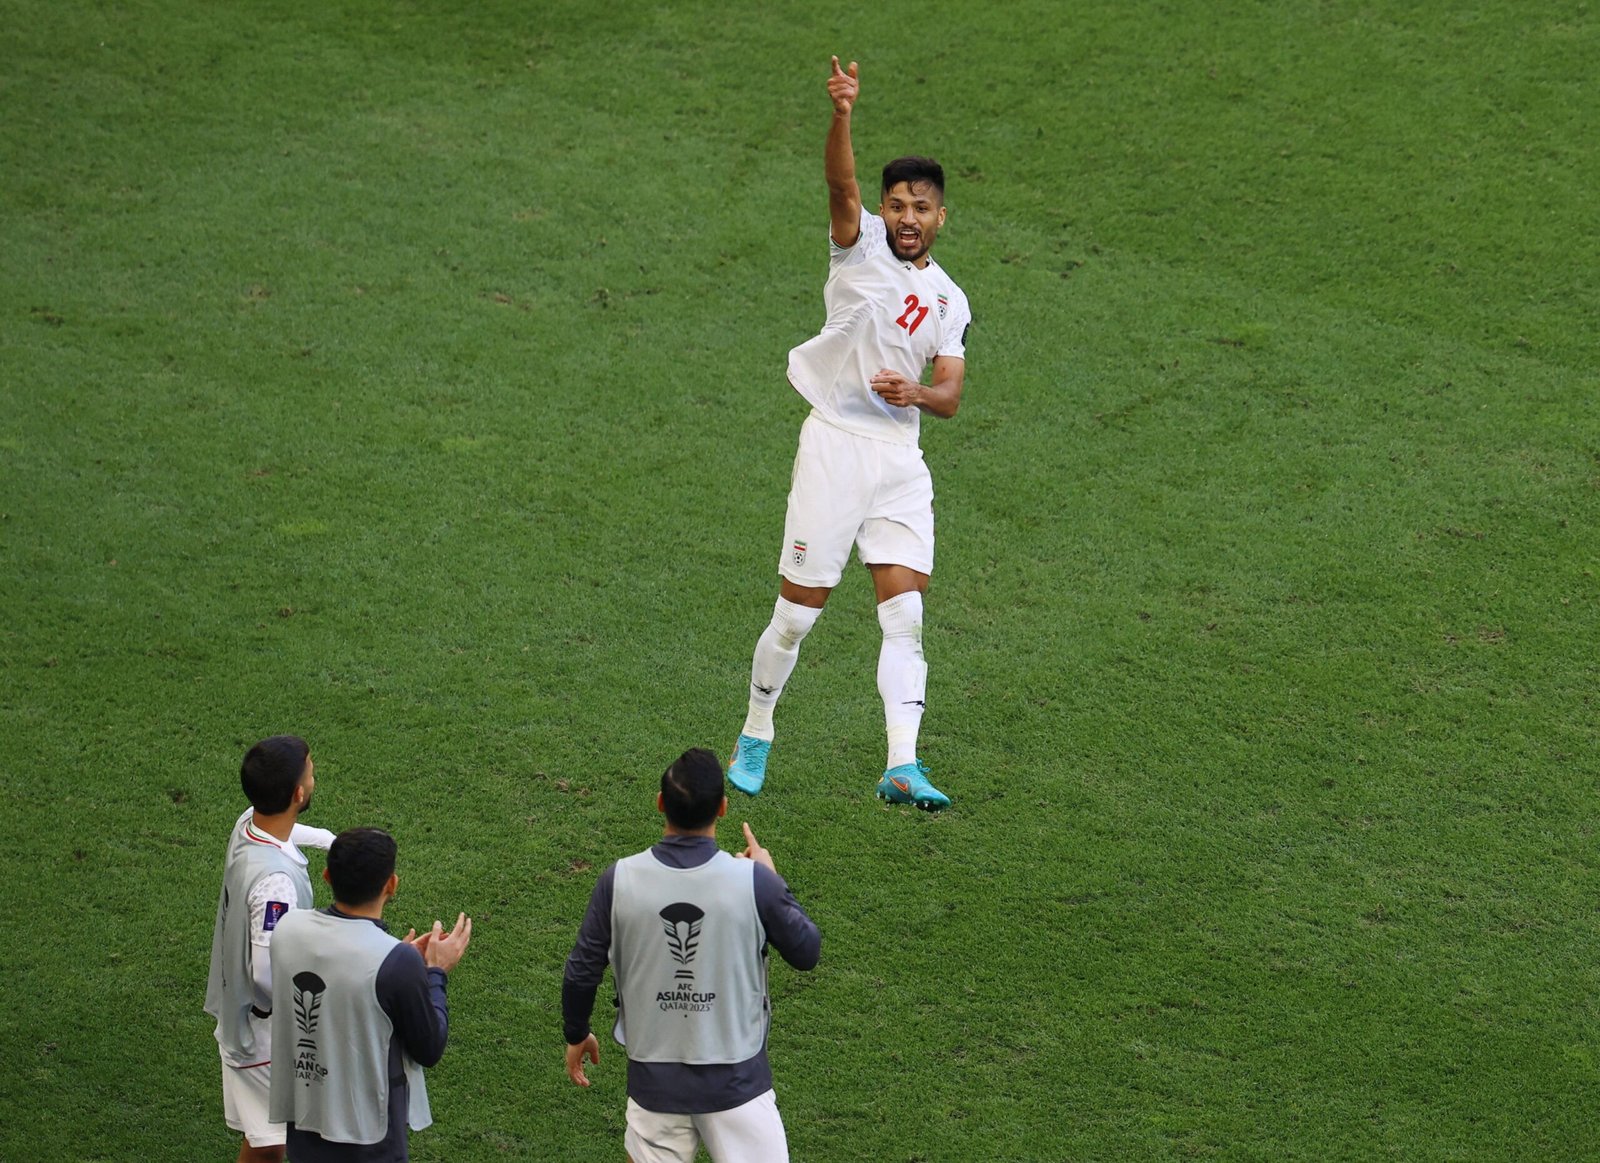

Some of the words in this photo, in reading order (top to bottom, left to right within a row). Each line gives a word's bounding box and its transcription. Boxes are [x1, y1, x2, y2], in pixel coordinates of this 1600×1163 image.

[896, 294, 930, 337] 21
[677, 983, 693, 991] AFC
[656, 991, 690, 1001] ASIAN
[691, 992, 716, 1003] CUP
[659, 1002, 688, 1011] QATAR
[299, 1051, 316, 1061] AFC
[294, 1058, 314, 1071] IAN
[315, 1063, 328, 1077] CP
[295, 1070, 311, 1080] TAR
